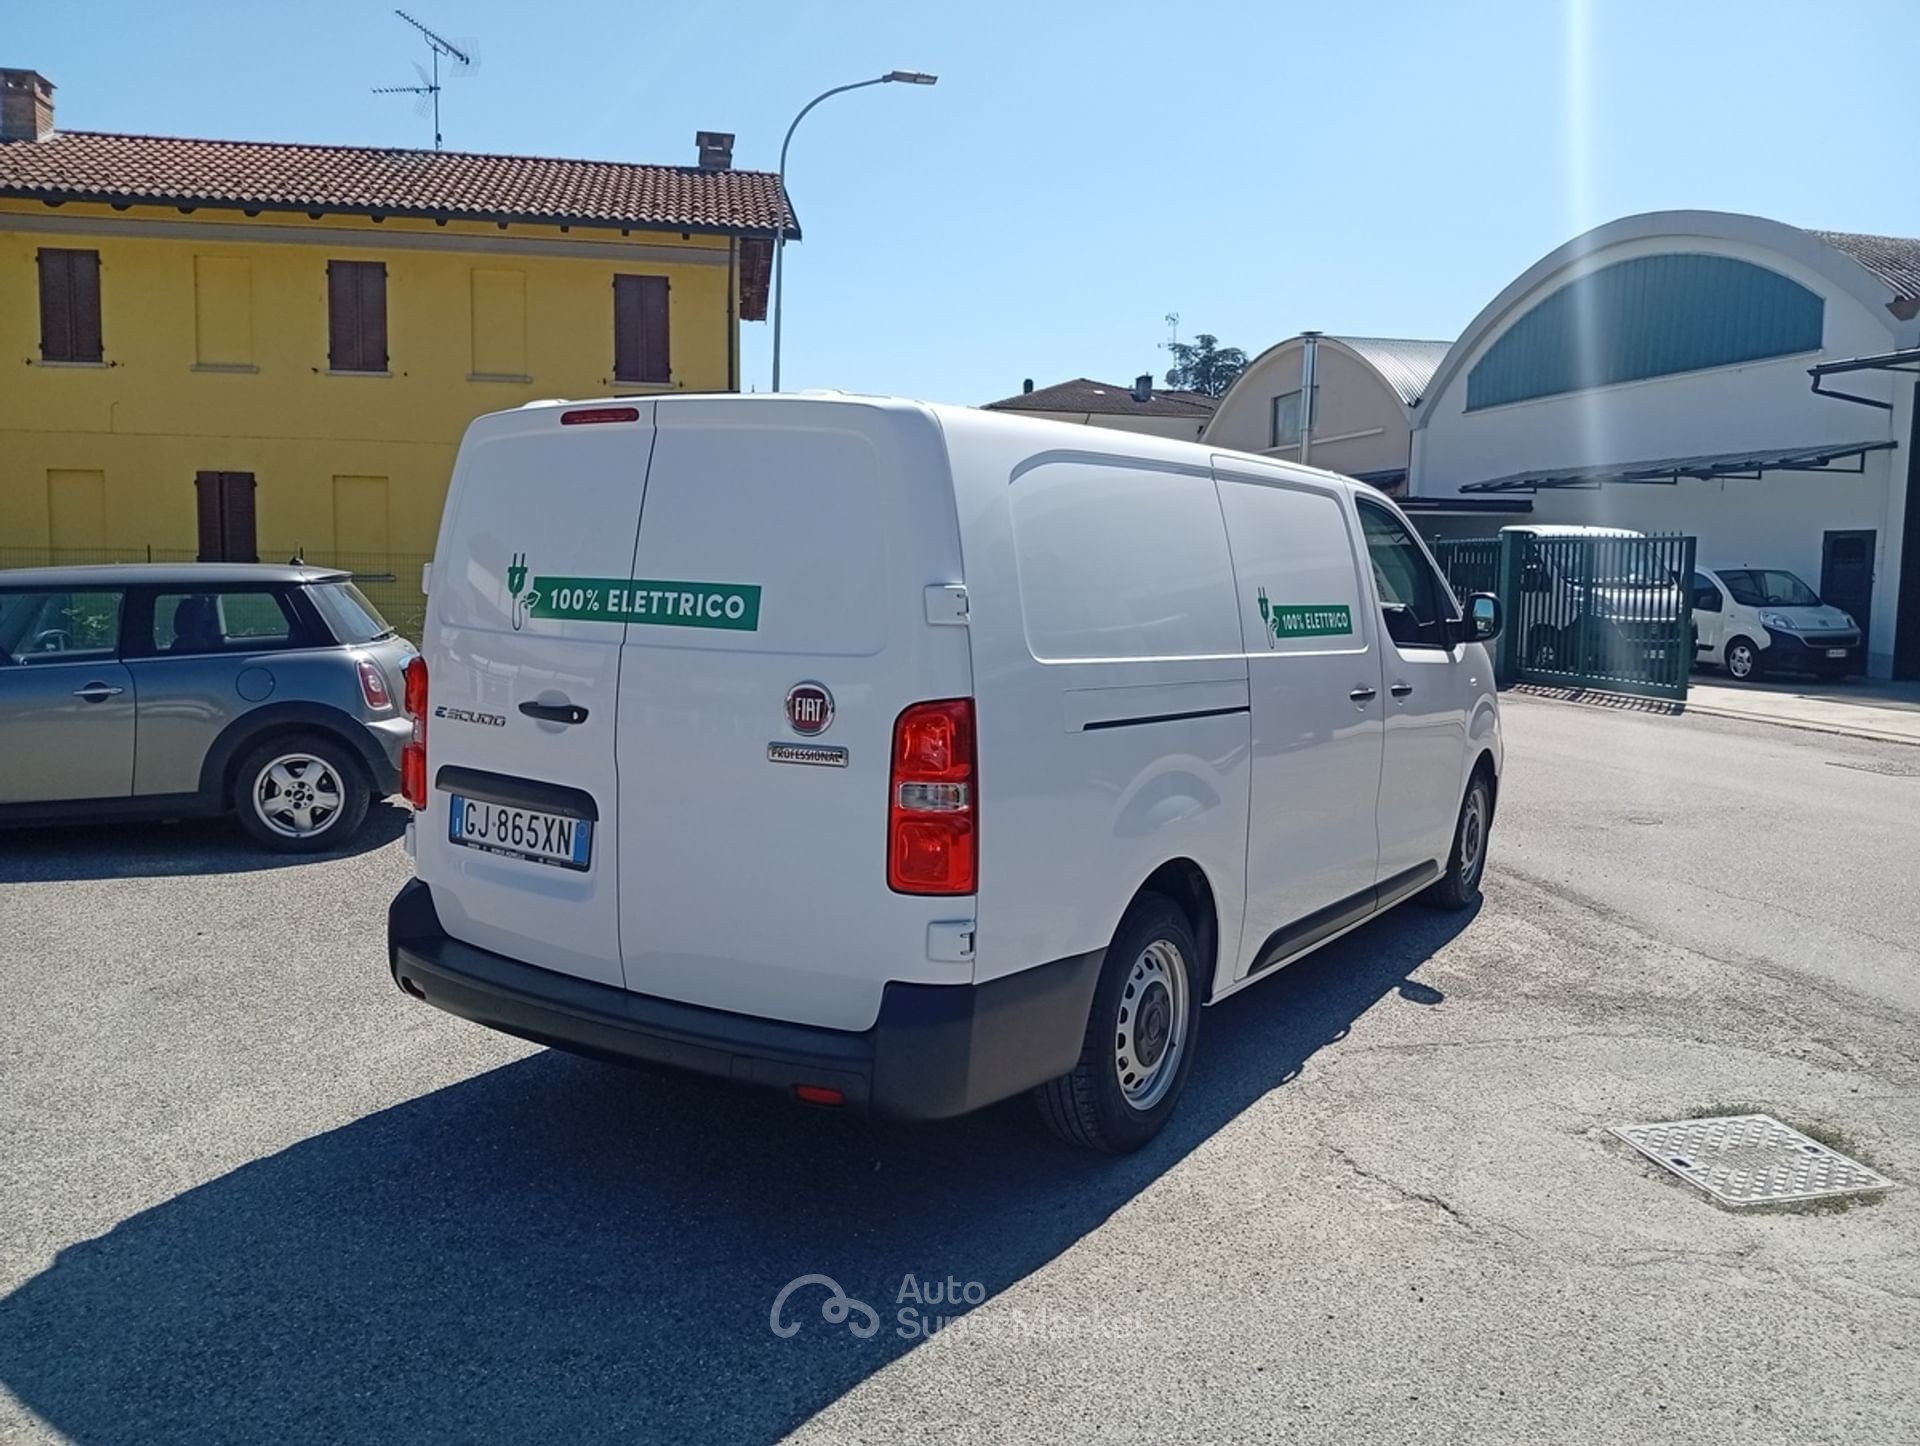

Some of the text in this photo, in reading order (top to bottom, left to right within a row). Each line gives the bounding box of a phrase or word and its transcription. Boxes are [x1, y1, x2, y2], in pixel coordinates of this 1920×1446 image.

[550, 588, 745, 620] 100% ELETTRICO
[1282, 612, 1349, 631] 100% ELETTRICO
[795, 697, 824, 722] FIAT
